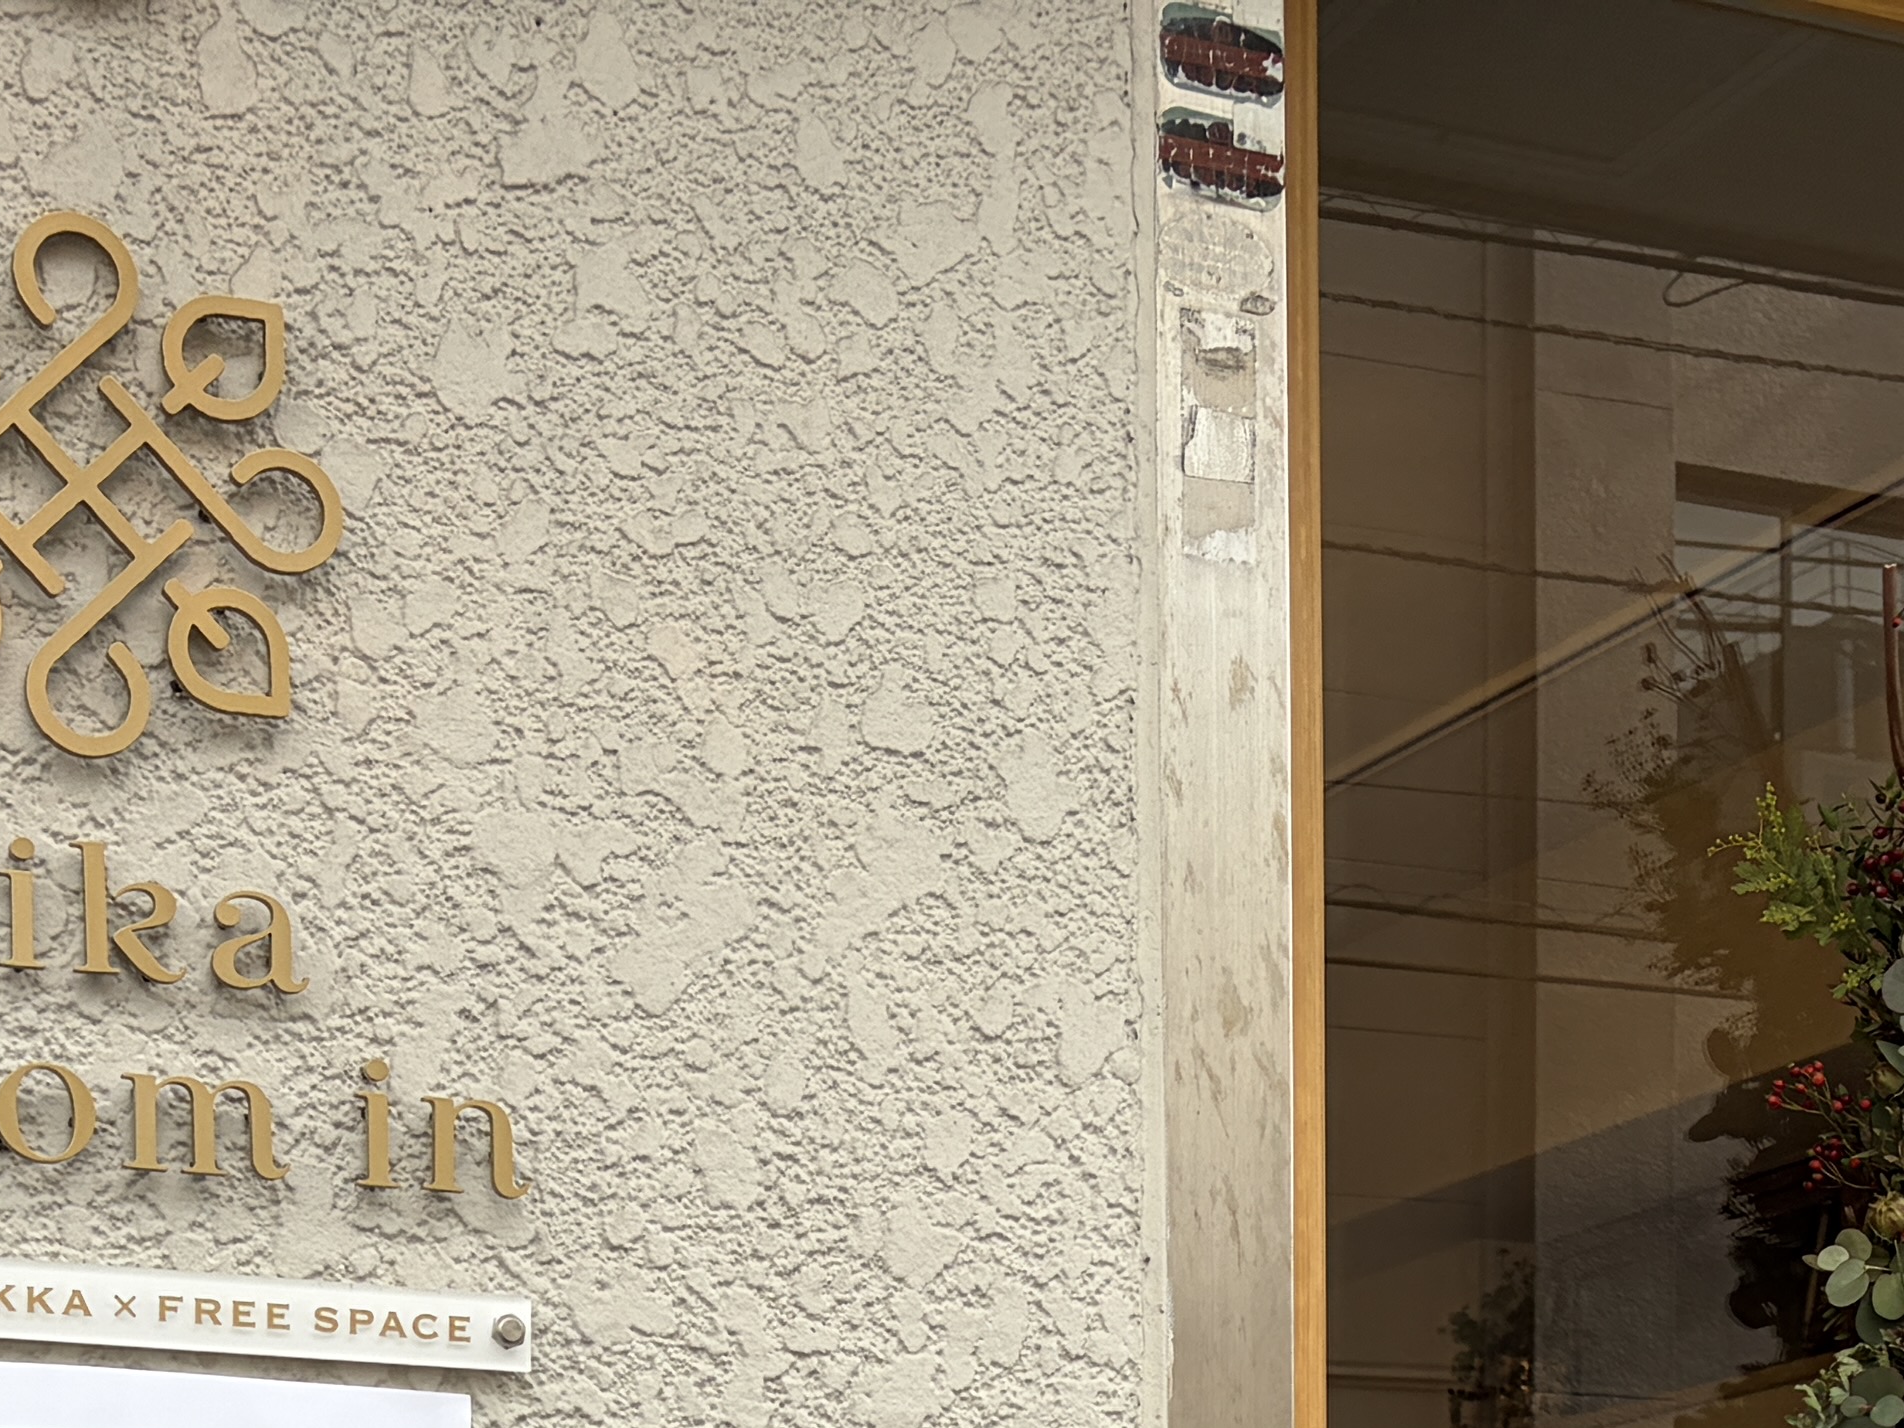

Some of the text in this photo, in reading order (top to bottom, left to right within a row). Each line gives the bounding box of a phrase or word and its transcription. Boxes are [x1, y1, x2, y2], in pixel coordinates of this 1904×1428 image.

[355, 1057, 531, 1199] in
[158, 1296, 292, 1331] FREE
[314, 1306, 472, 1343] SPACE
